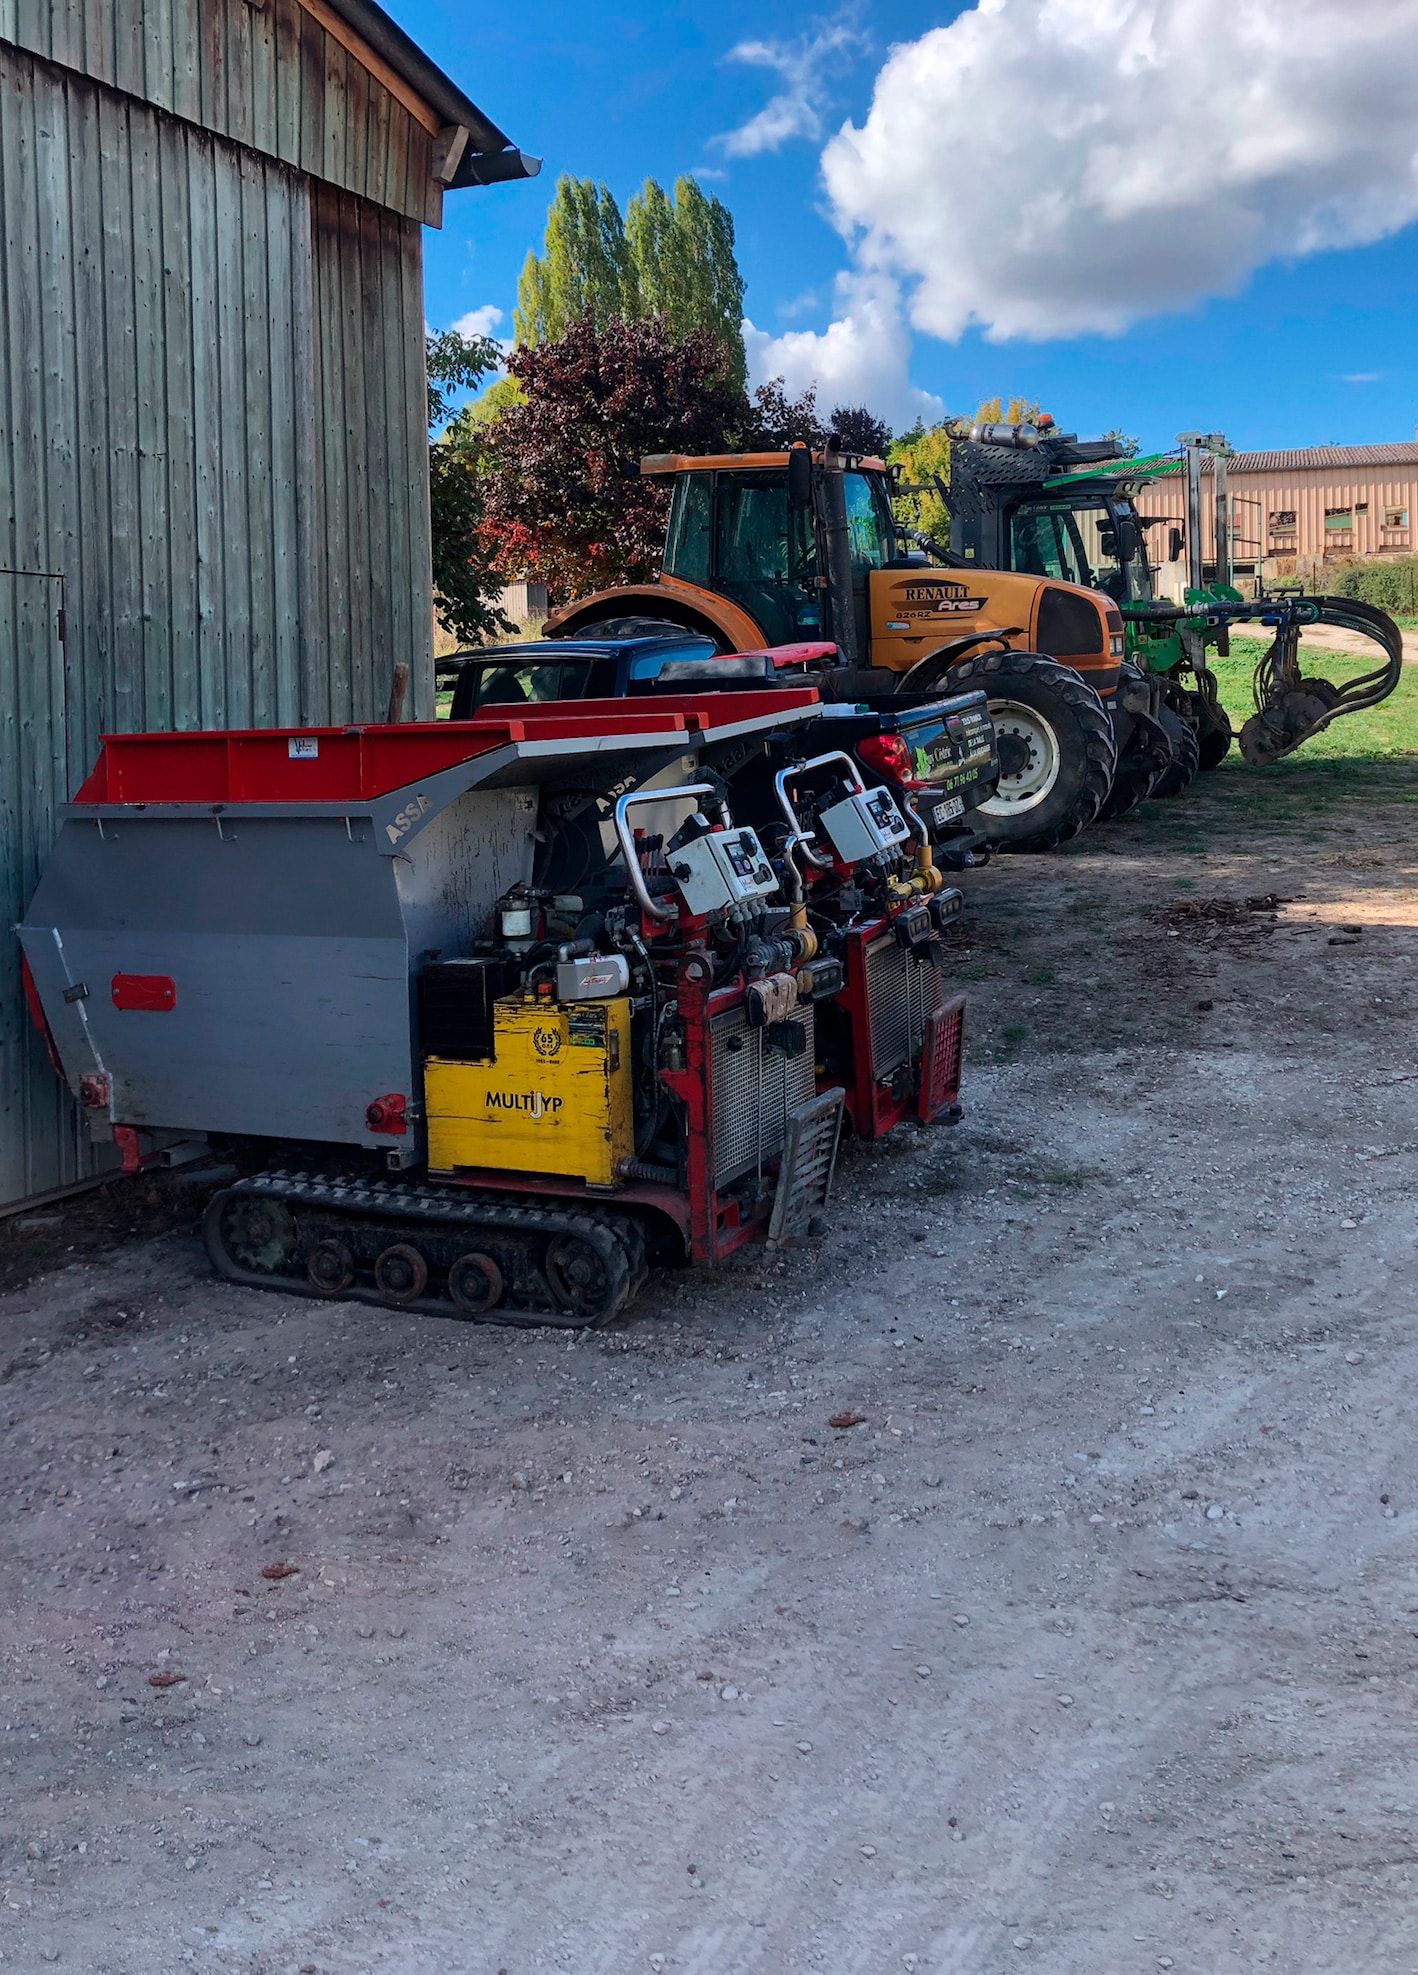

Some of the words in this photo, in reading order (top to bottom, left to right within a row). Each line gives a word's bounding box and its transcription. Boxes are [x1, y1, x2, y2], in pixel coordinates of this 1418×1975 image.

[905, 586, 970, 600] RENAULT
[938, 600, 980, 611] Ares
[385, 794, 432, 845] ASSA
[541, 1033, 553, 1043] 65
